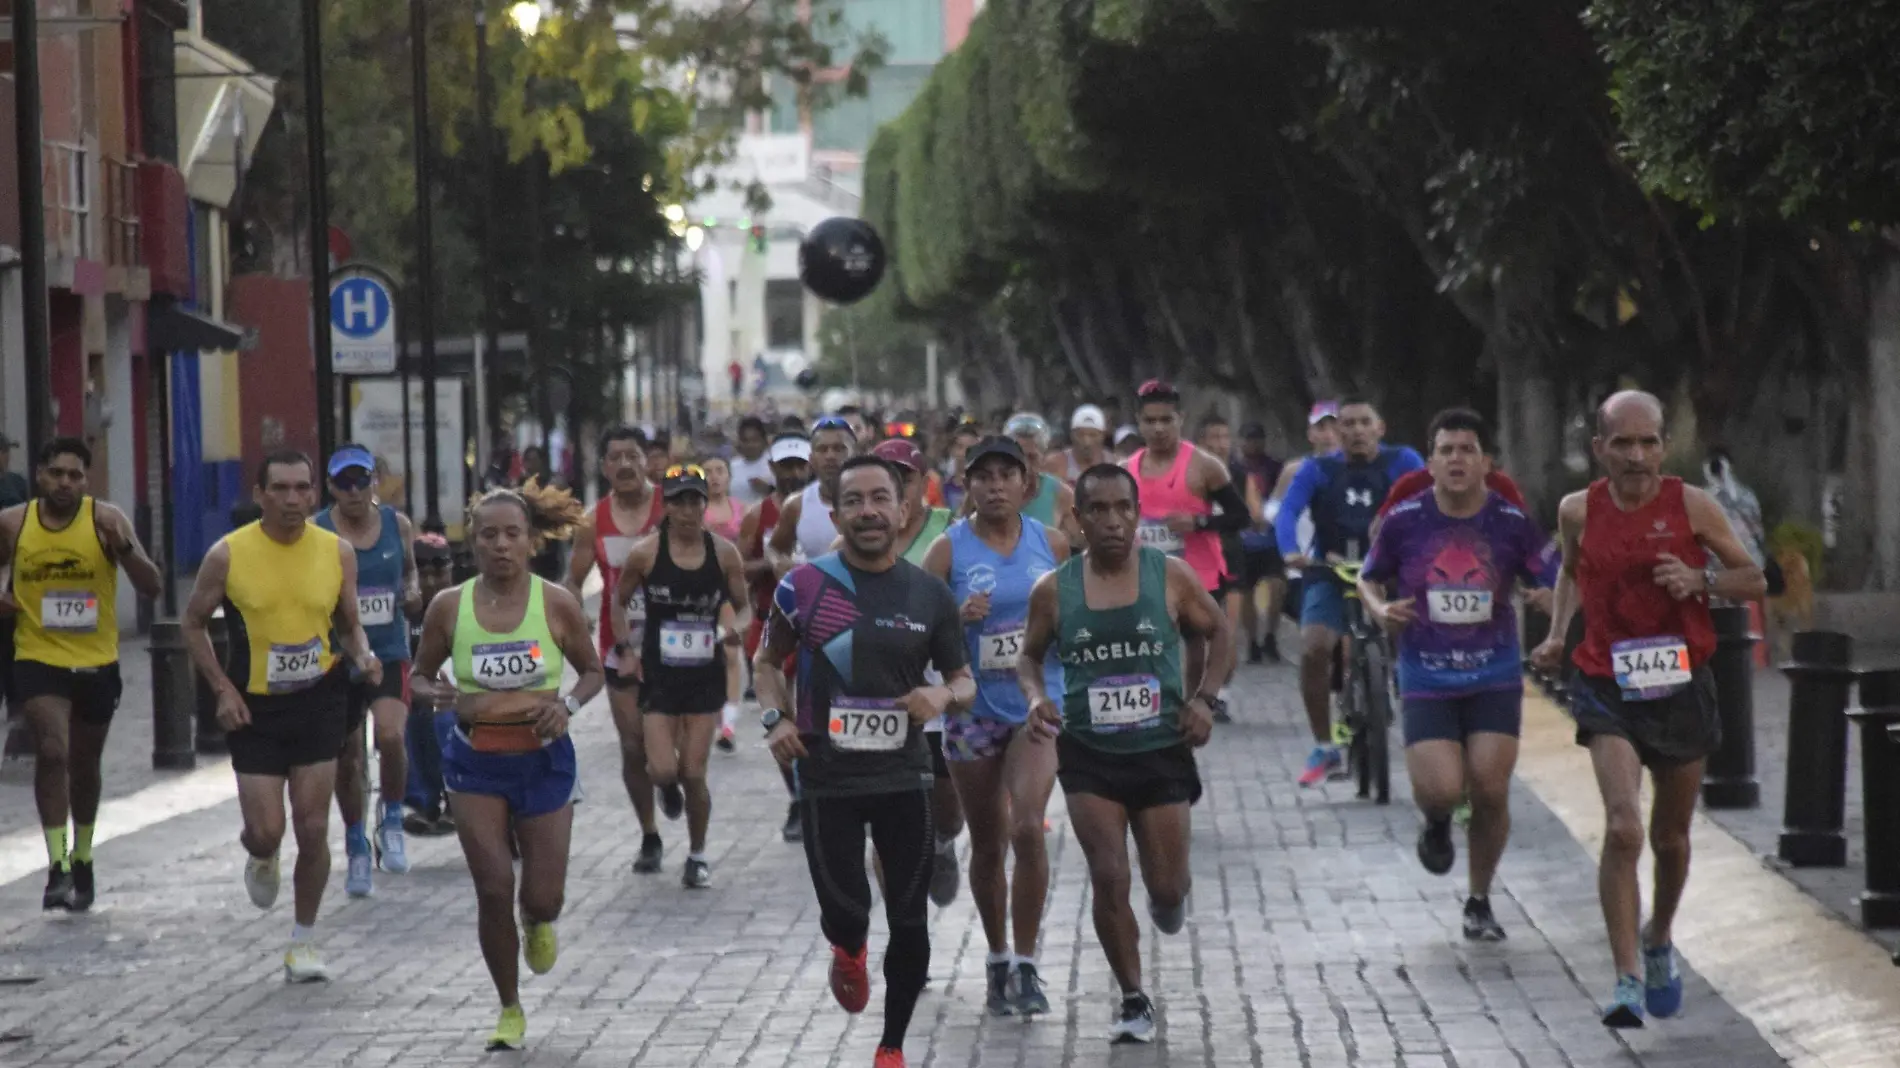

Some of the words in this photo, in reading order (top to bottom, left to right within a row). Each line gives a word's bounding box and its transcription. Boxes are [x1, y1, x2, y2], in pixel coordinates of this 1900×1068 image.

[342, 287, 376, 329] H
[1140, 528, 1174, 543] 478
[55, 600, 85, 616] 179
[1440, 594, 1480, 612] 302
[682, 632, 693, 649] 8
[992, 633, 1025, 657] 23
[275, 650, 319, 672] 3674
[479, 655, 537, 677] 4303
[1618, 650, 1681, 676] 3442
[1098, 687, 1152, 712] 2148
[840, 713, 898, 736] 1790
